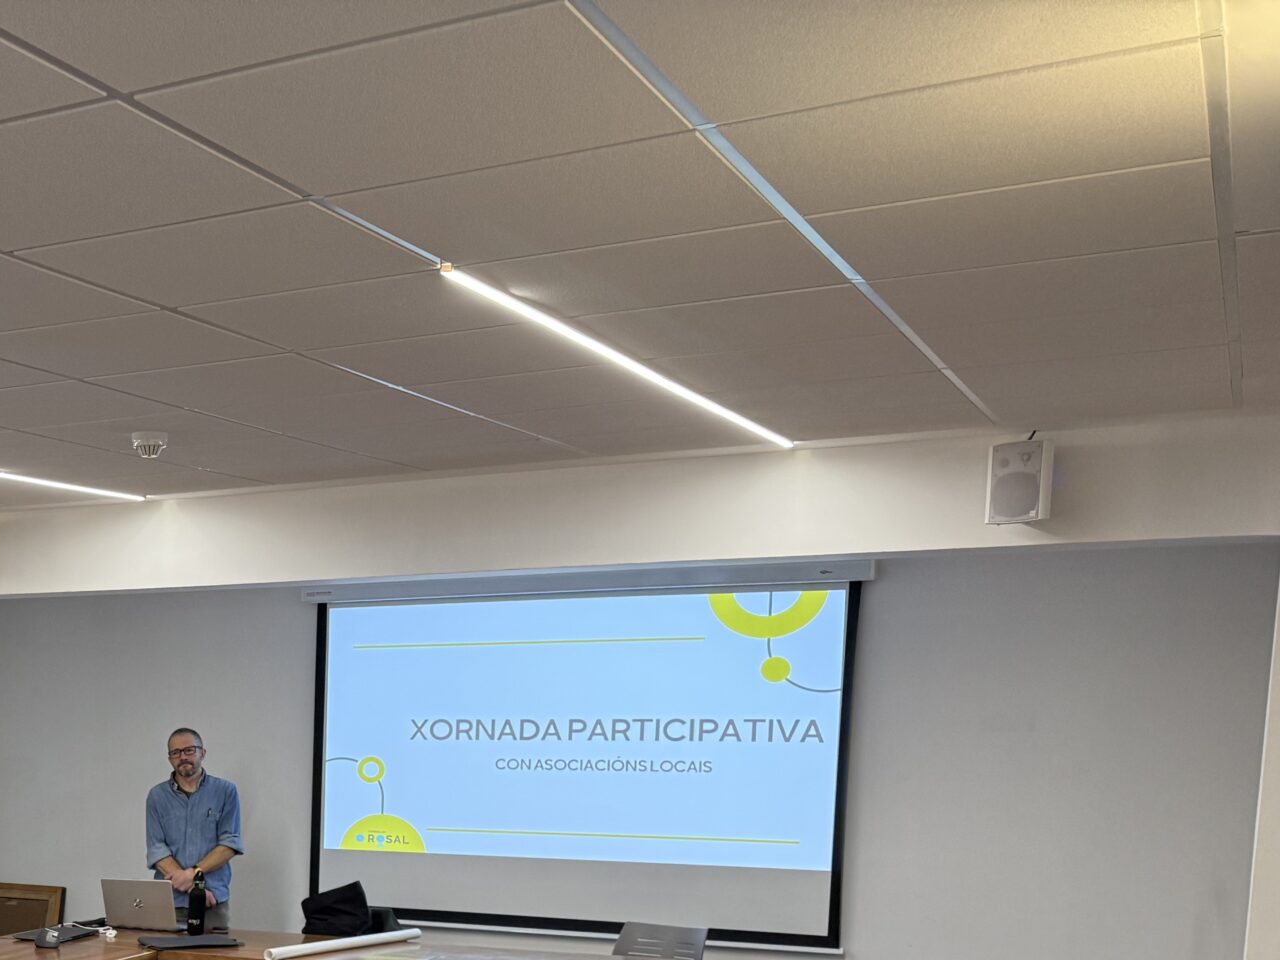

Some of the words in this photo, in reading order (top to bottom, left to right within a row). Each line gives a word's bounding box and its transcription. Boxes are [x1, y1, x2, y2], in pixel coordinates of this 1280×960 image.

[410, 718, 562, 741] XORNADA
[568, 718, 824, 743] PARTICIPATIVA
[495, 758, 531, 771] CON
[533, 756, 647, 772] ASOCIACIÓNS
[649, 760, 713, 774] LOCAIS
